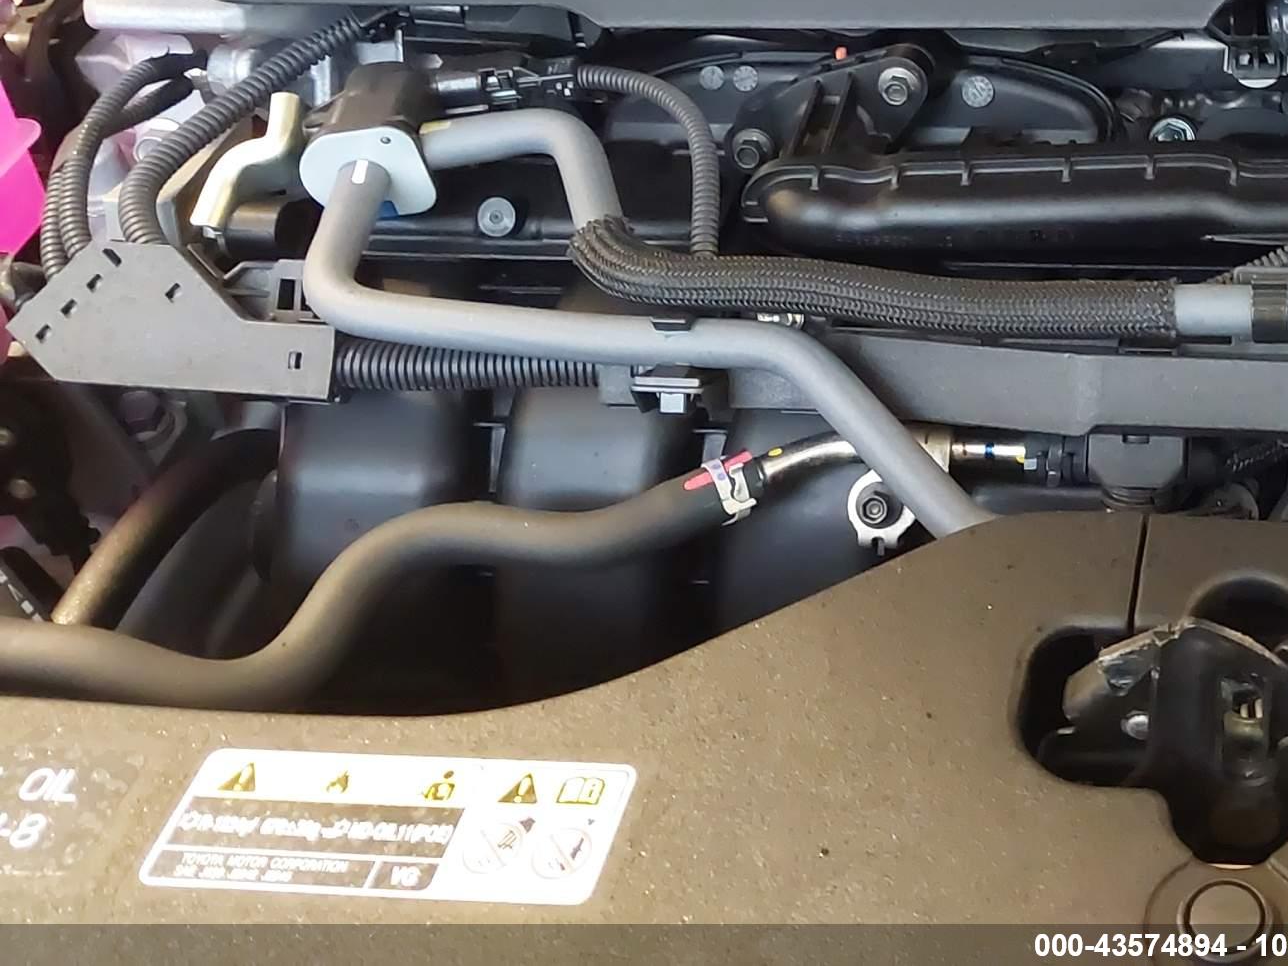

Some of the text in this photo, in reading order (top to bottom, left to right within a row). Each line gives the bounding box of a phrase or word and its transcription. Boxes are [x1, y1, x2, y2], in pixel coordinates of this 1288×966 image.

[19, 767, 77, 802] OIL
[181, 851, 349, 873] TOYOTA MOTOR CORPORATION
